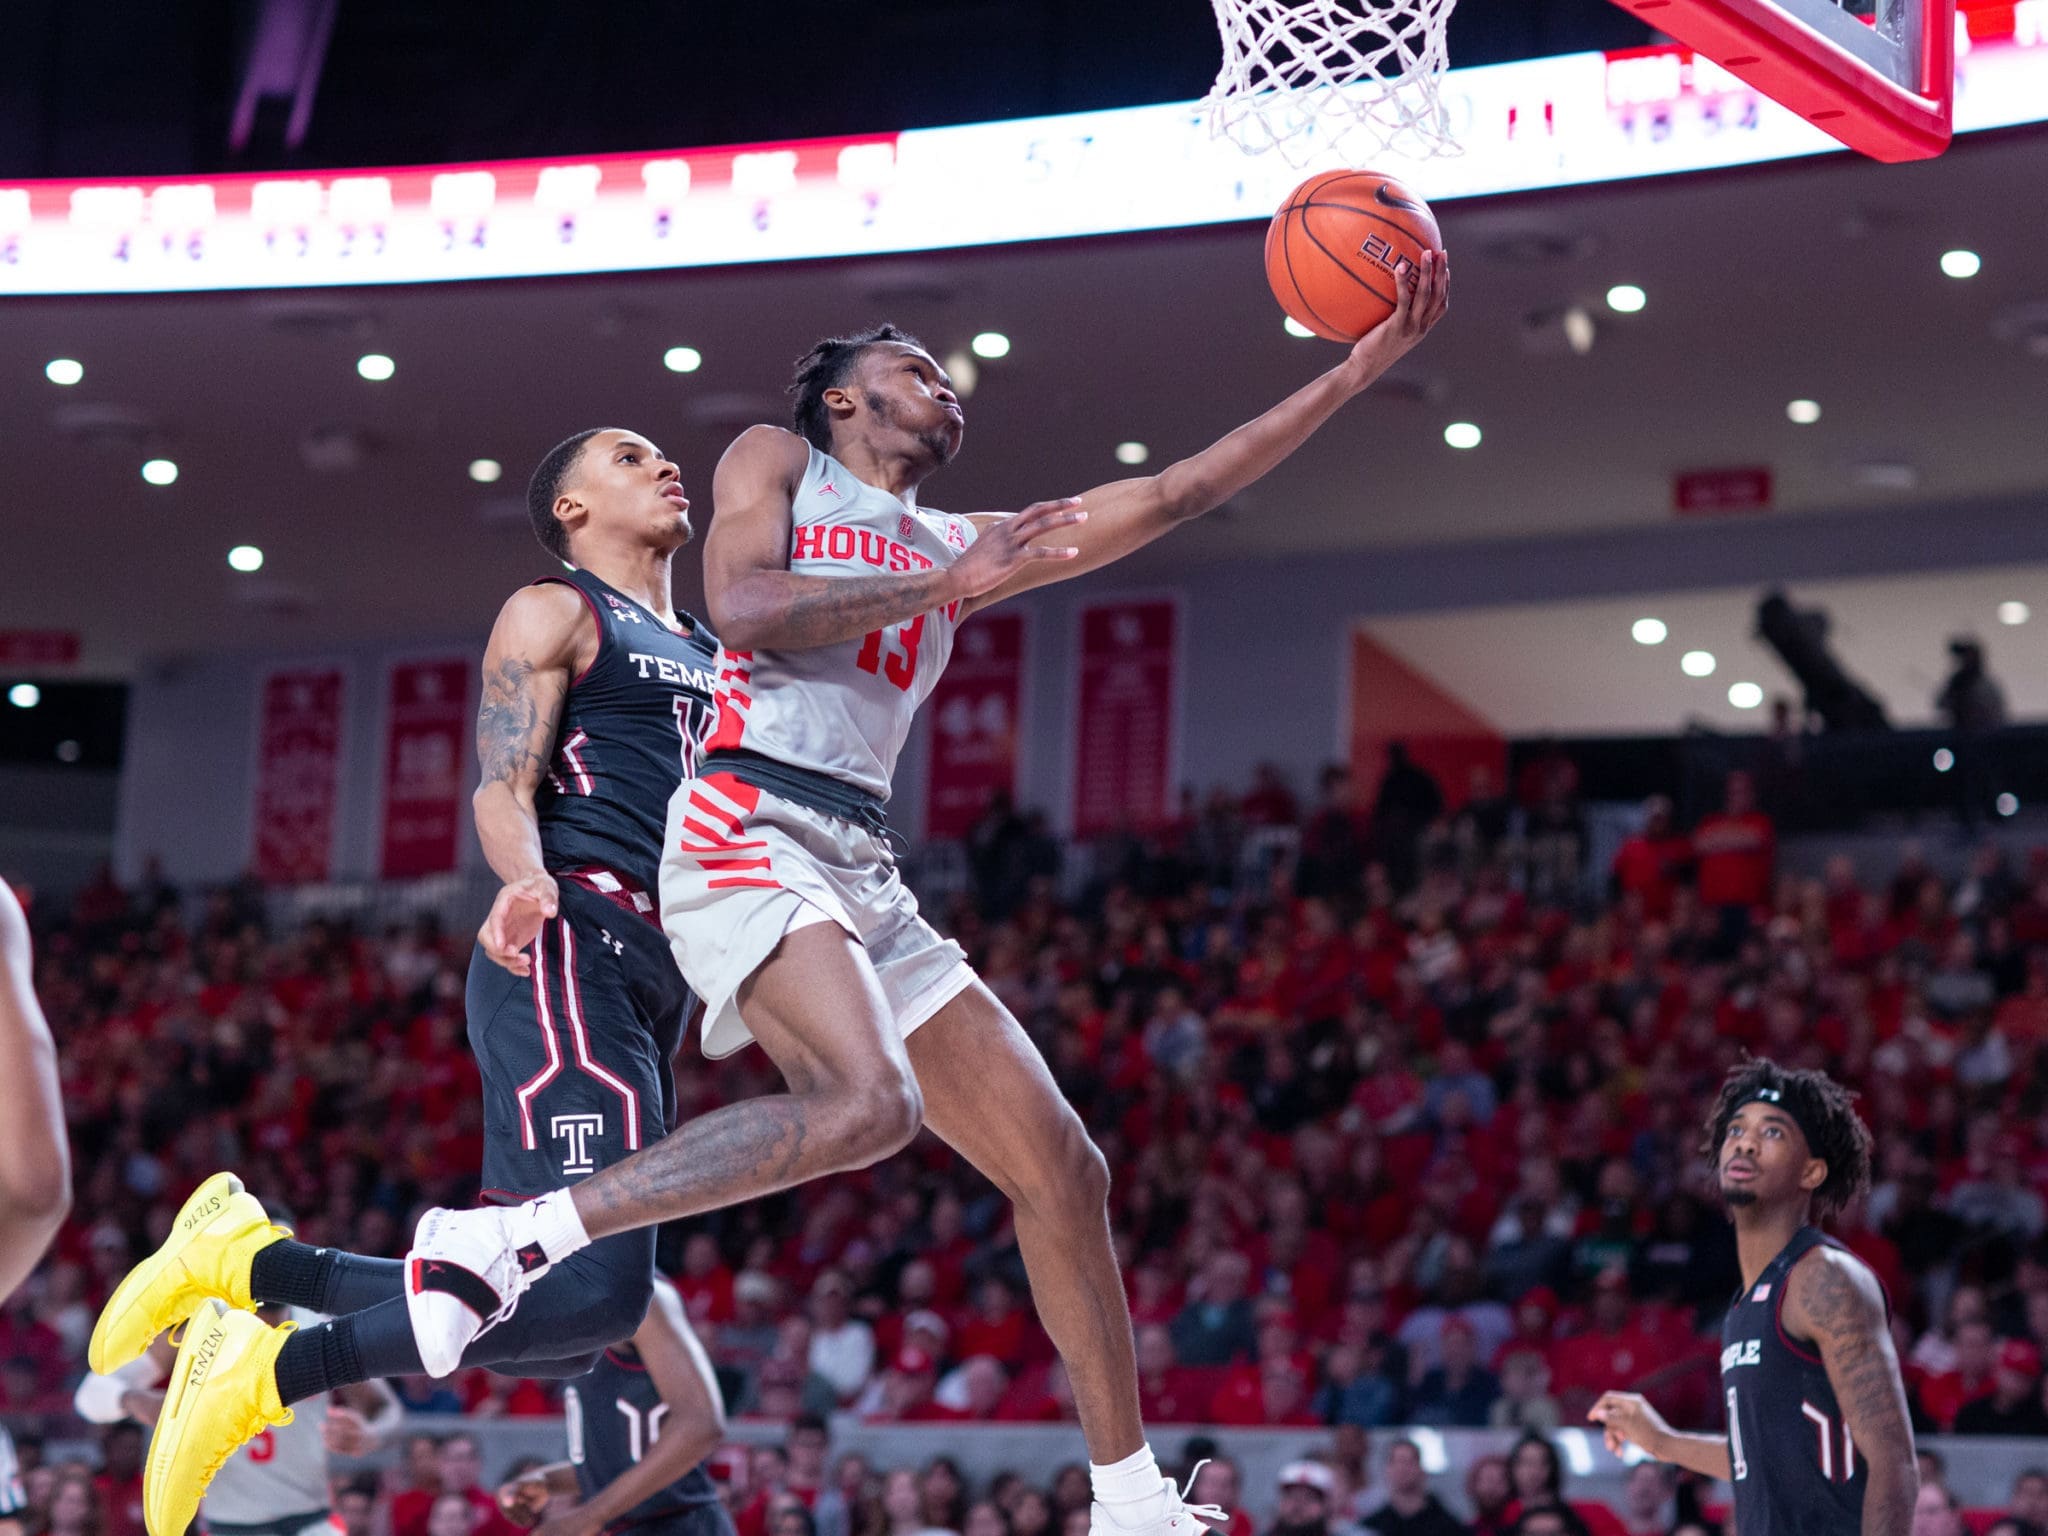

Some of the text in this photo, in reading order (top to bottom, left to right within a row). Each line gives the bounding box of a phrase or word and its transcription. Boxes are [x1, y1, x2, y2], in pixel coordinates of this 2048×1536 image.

[791, 524, 934, 572] HOUST
[628, 652, 717, 694] TEMP
[856, 613, 925, 692] 13
[551, 1114, 603, 1175] T
